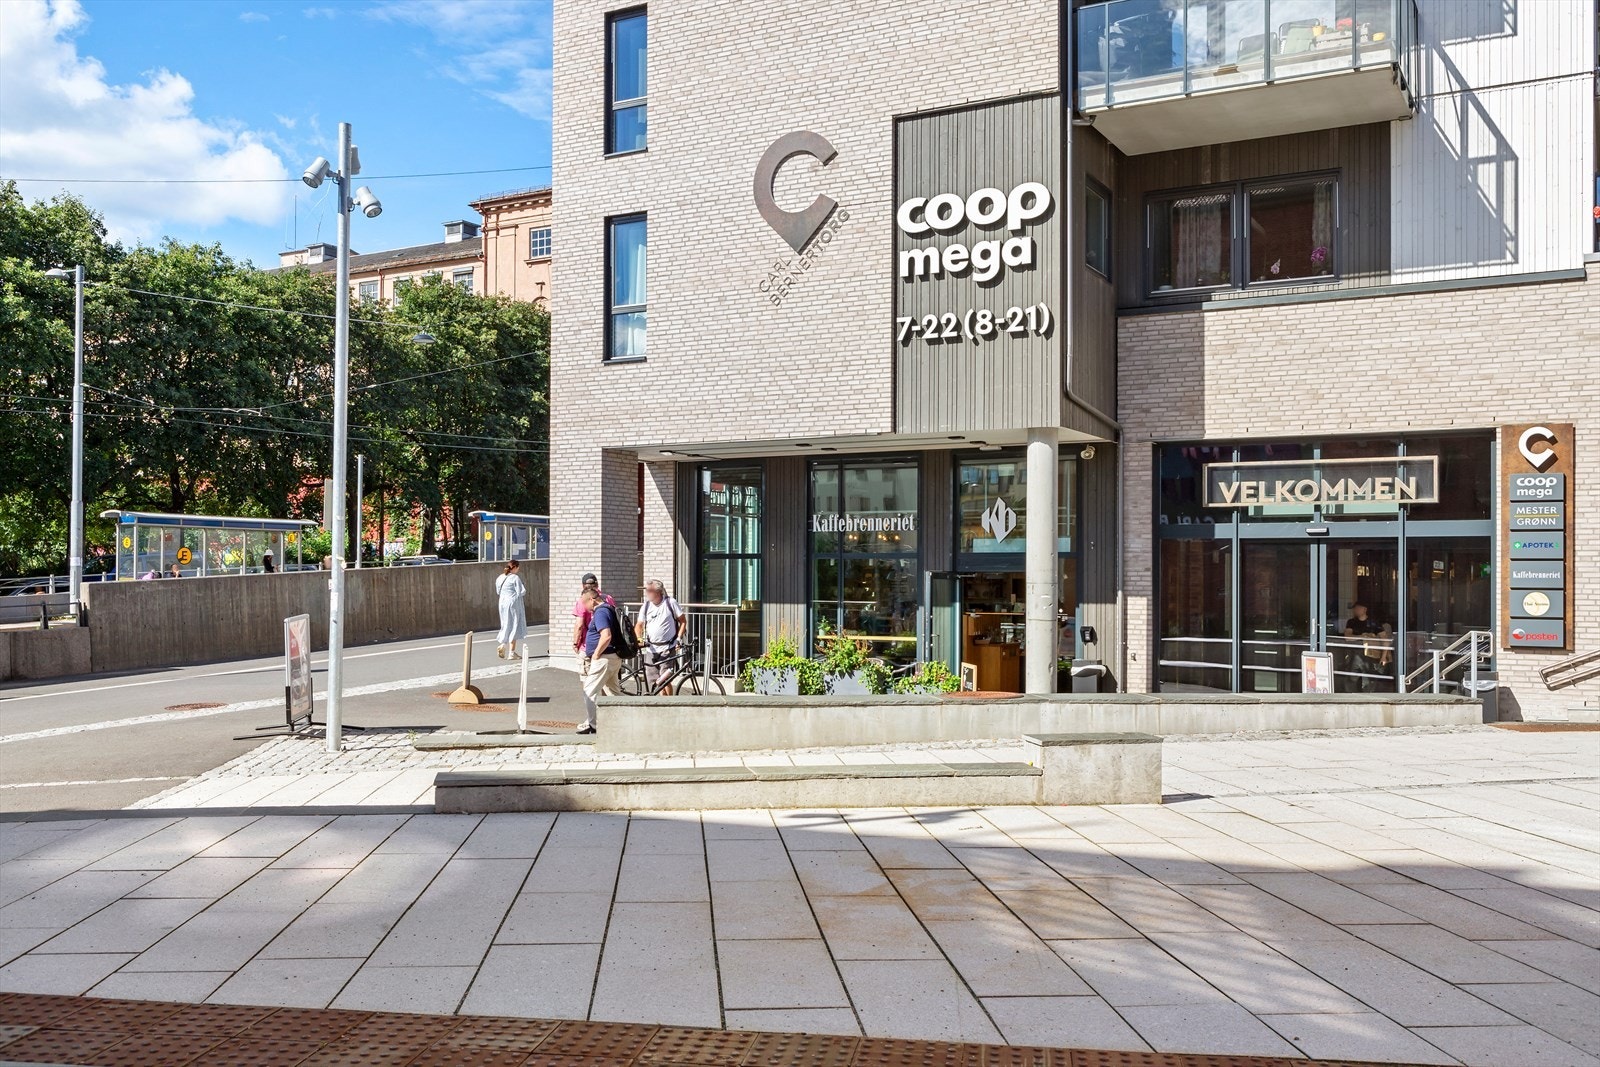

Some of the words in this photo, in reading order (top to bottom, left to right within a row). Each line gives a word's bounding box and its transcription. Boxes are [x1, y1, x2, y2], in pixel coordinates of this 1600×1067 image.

[897, 182, 1051, 233] coop
[769, 208, 850, 307] BERNERTORG
[899, 236, 1032, 282] mega
[759, 257, 792, 293] CARL
[896, 312, 958, 341] 7-22
[964, 302, 1050, 340] (8-21)
[1218, 476, 1418, 504] VELKOMMEN
[1516, 477, 1557, 487] coop
[1516, 488, 1552, 498] mega
[1516, 506, 1557, 514] MESTER
[812, 513, 915, 532] Kaffebrenneriet
[1516, 517, 1555, 526] GRØNN
[1512, 571, 1561, 579] Kaffebrenneriet
[1525, 633, 1558, 641] posten
